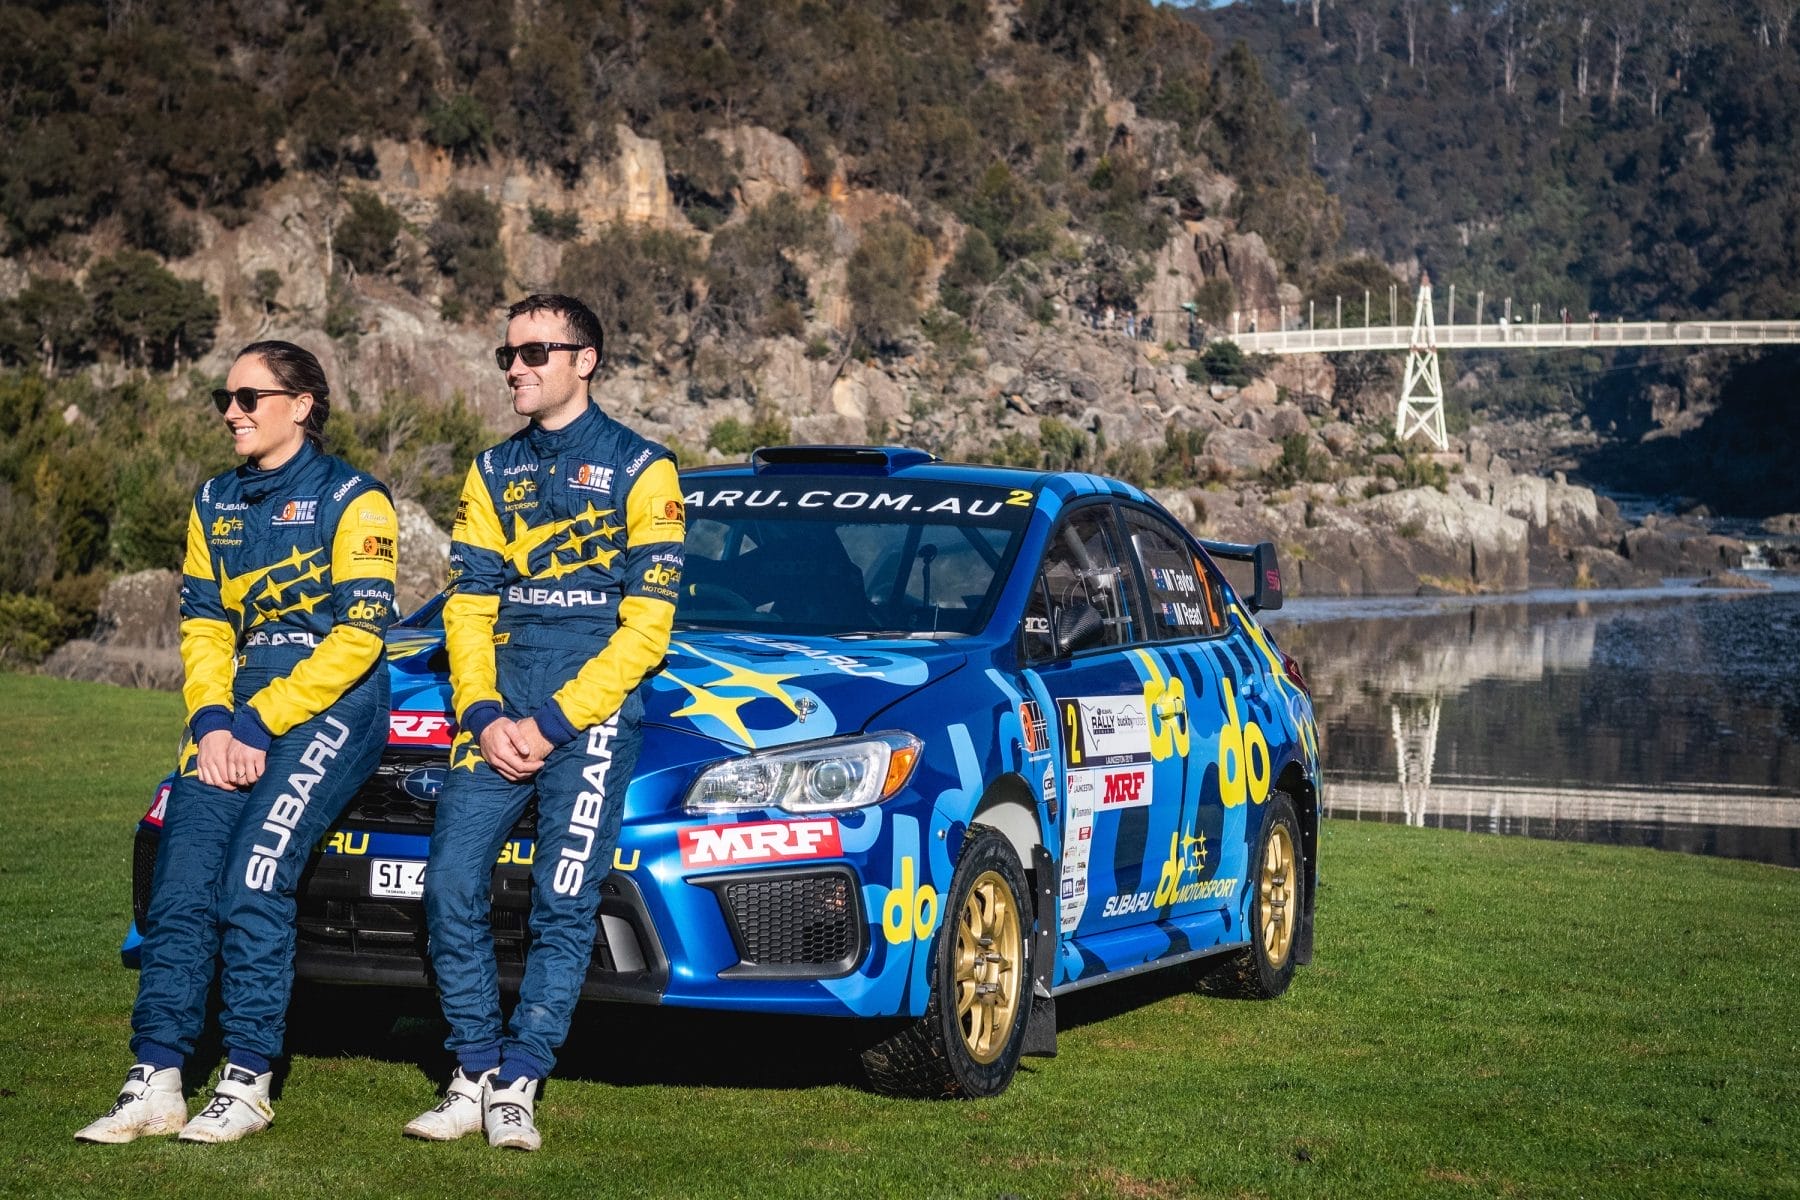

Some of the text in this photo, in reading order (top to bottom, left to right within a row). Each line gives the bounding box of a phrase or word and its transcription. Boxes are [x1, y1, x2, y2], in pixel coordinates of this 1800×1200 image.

[626, 448, 653, 477] Sabelt
[333, 475, 362, 502] Sabelt
[1005, 490, 1034, 507] 2
[353, 589, 392, 601] SUBARU
[508, 586, 607, 608] SUBARU
[1161, 568, 1196, 597] M Taylor
[1172, 602, 1204, 626] M Read
[723, 633, 886, 677] SUBARU
[1066, 703, 1081, 764] 2
[1091, 716, 1115, 729] RALLY
[1219, 677, 1271, 809] do
[1103, 771, 1145, 804] MRF
[245, 716, 351, 893] SUBARU
[689, 821, 832, 864] MRF
[882, 856, 938, 945] do
[1102, 890, 1155, 917] SUBARU
[1176, 879, 1239, 905] MOTORSPORT
